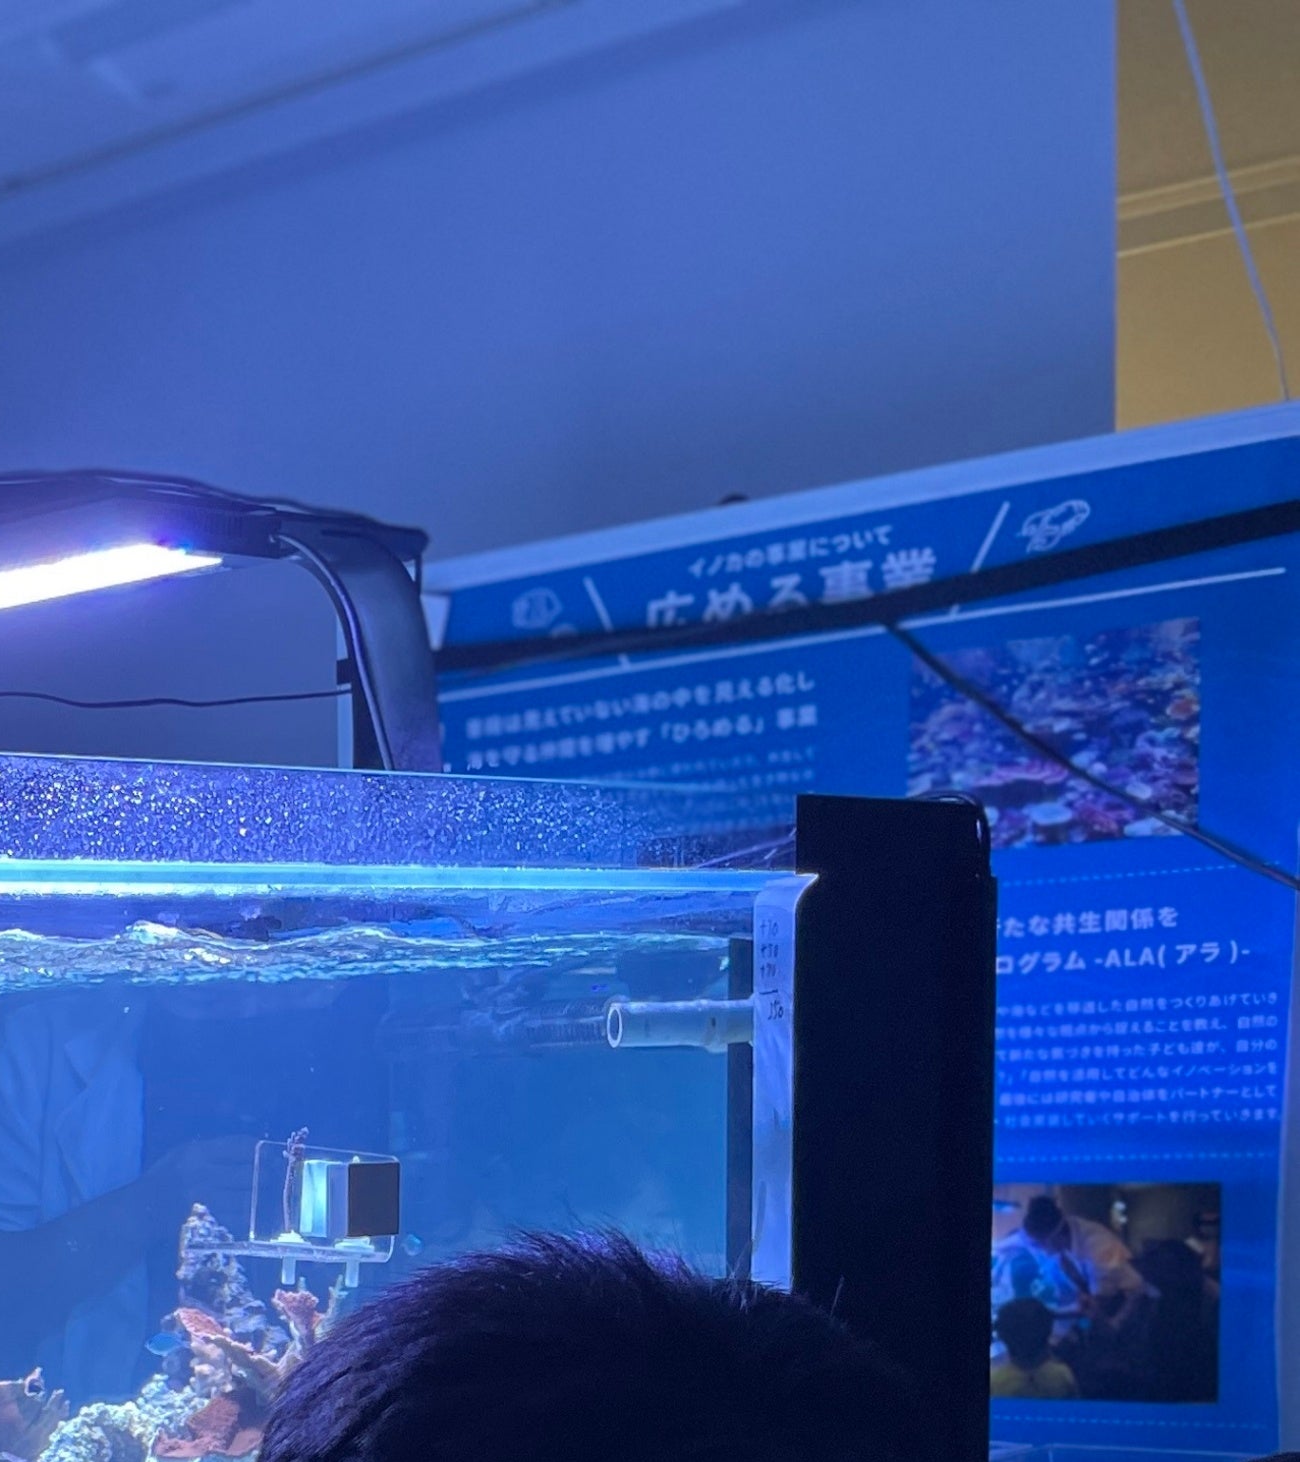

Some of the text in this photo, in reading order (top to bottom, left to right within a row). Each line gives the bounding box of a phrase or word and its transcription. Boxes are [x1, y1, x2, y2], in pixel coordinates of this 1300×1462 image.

[996, 906, 1180, 938] たな共生関係を
